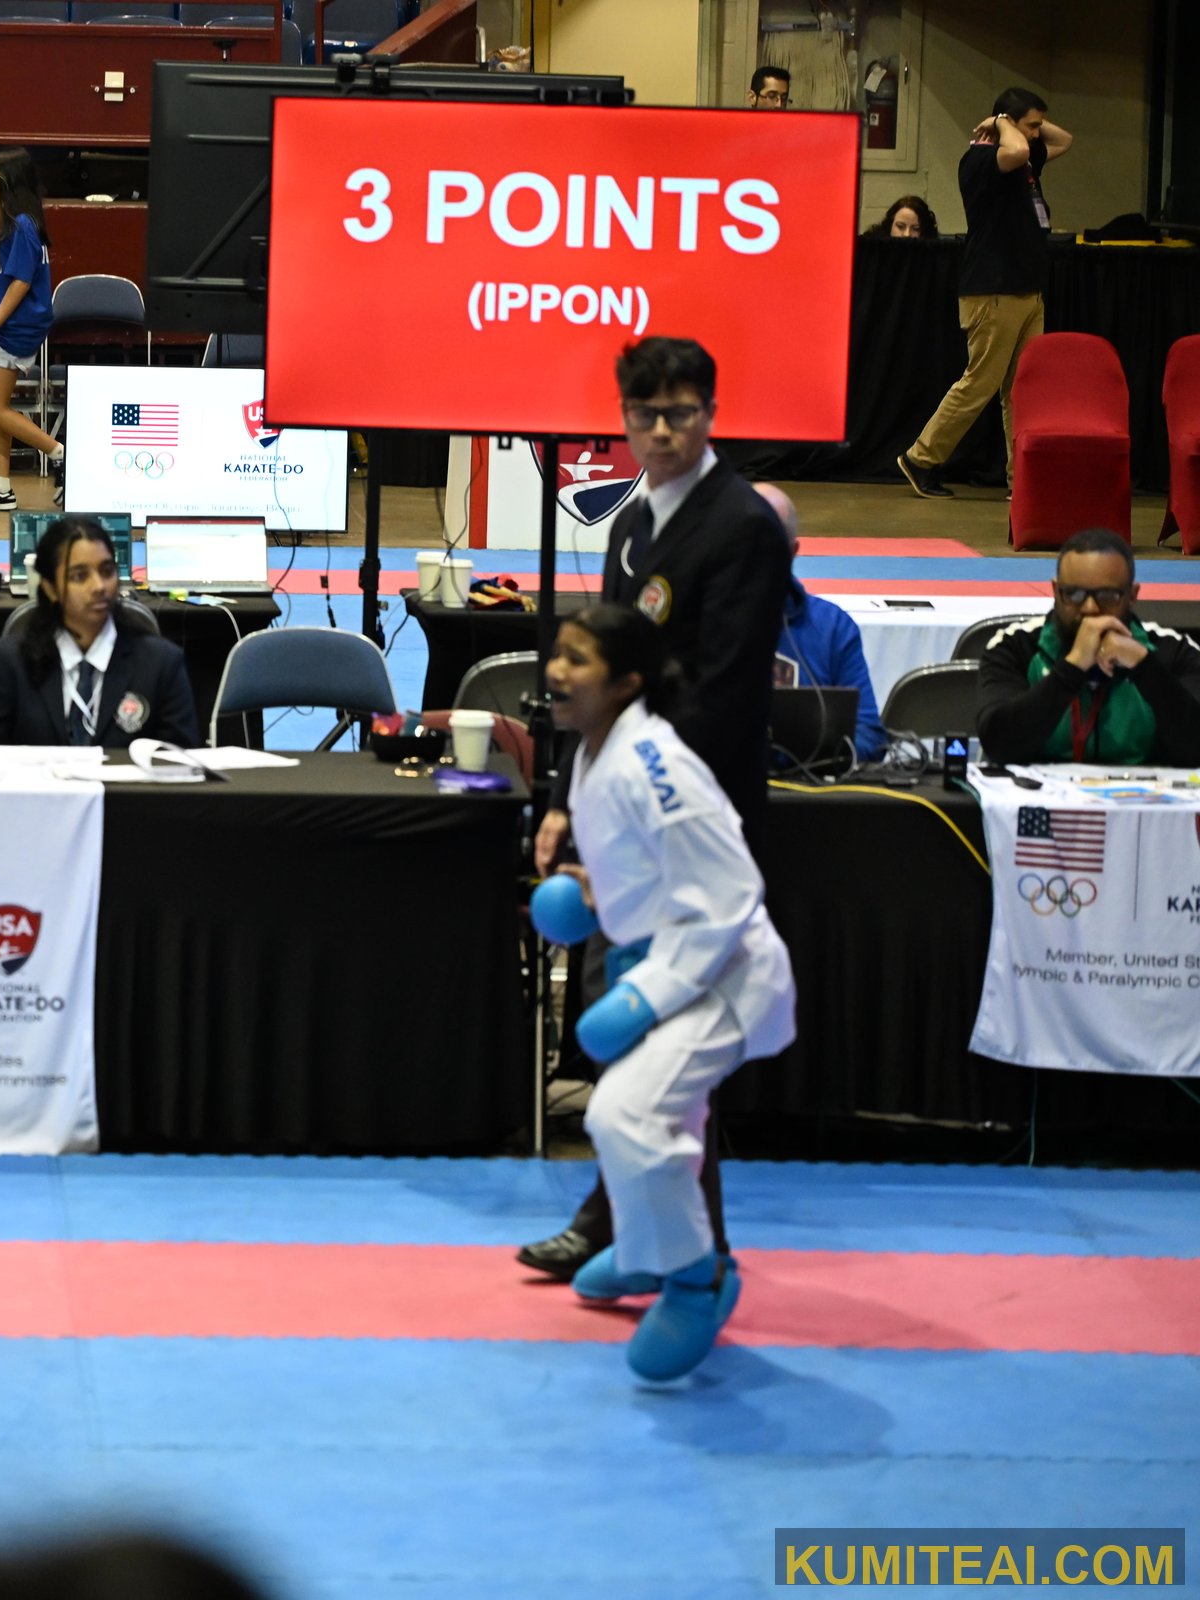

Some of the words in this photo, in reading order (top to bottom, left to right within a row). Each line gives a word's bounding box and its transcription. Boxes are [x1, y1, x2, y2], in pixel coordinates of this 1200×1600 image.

[343, 168, 393, 243] 3
[426, 169, 781, 254] POINTS
[468, 281, 650, 336] (IPPON)
[224, 463, 304, 474] KARATE-DO
[1046, 947, 1117, 968] Member,
[1124, 952, 1179, 968] United
[1088, 970, 1182, 990] Paralympic
